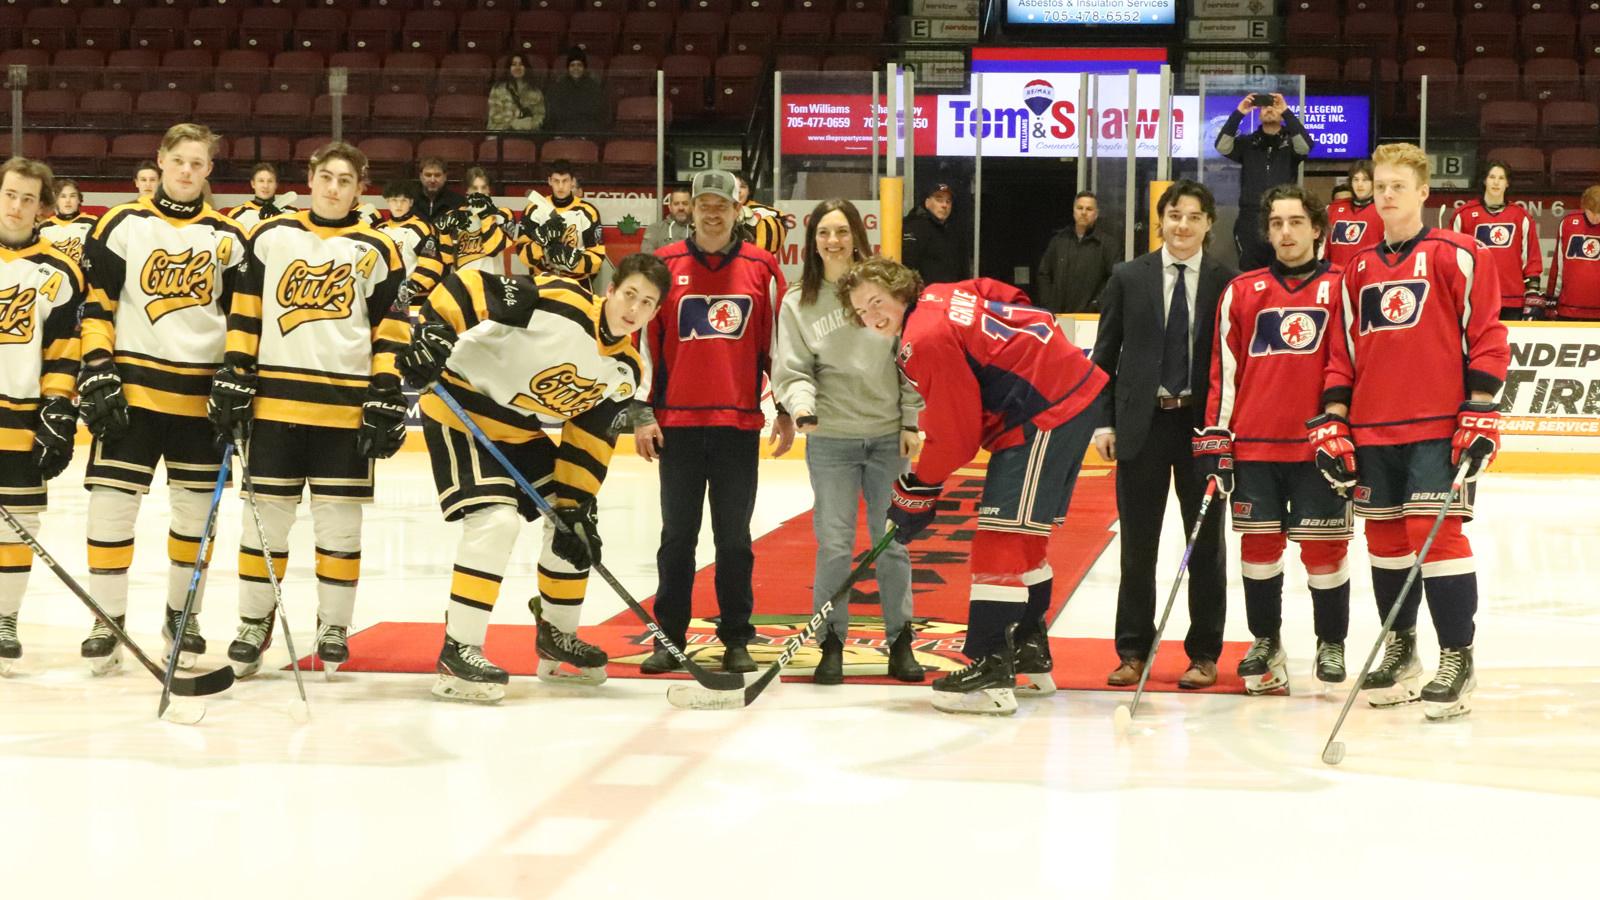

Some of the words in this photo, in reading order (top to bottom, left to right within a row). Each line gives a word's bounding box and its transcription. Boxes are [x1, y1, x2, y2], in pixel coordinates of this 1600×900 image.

[1044, 11, 1140, 21] 705-478-6552
[914, 20, 926, 36] E
[1253, 21, 1264, 37] E
[1253, 65, 1266, 81] D
[787, 104, 807, 114] Tom
[809, 104, 850, 114] Williams
[1309, 105, 1344, 114] LEGEND
[787, 117, 850, 128] 705-477-0659
[949, 100, 1029, 138] Tom
[1032, 122, 1046, 139] &
[1328, 114, 1346, 122] INC.
[693, 151, 705, 167] B
[1446, 157, 1459, 173] B
[160, 198, 196, 213] CCM
[583, 192, 652, 201] ECTION
[663, 193, 671, 205] 4
[1552, 201, 1564, 217] 6
[217, 236, 232, 265] A
[356, 248, 379, 279] A
[1413, 252, 1427, 277] A
[39, 271, 63, 302] A
[140, 248, 216, 325] Cubs
[1316, 280, 1330, 305] A
[276, 259, 356, 337] Cubs
[78, 373, 121, 392] TRUE
[214, 380, 257, 395] TRUE
[362, 401, 406, 413] TRUE
[1536, 420, 1599, 432] SERVICE
[1299, 518, 1345, 526] BAUER
[777, 600, 834, 668] BAUER
[646, 622, 687, 664] BAUER
